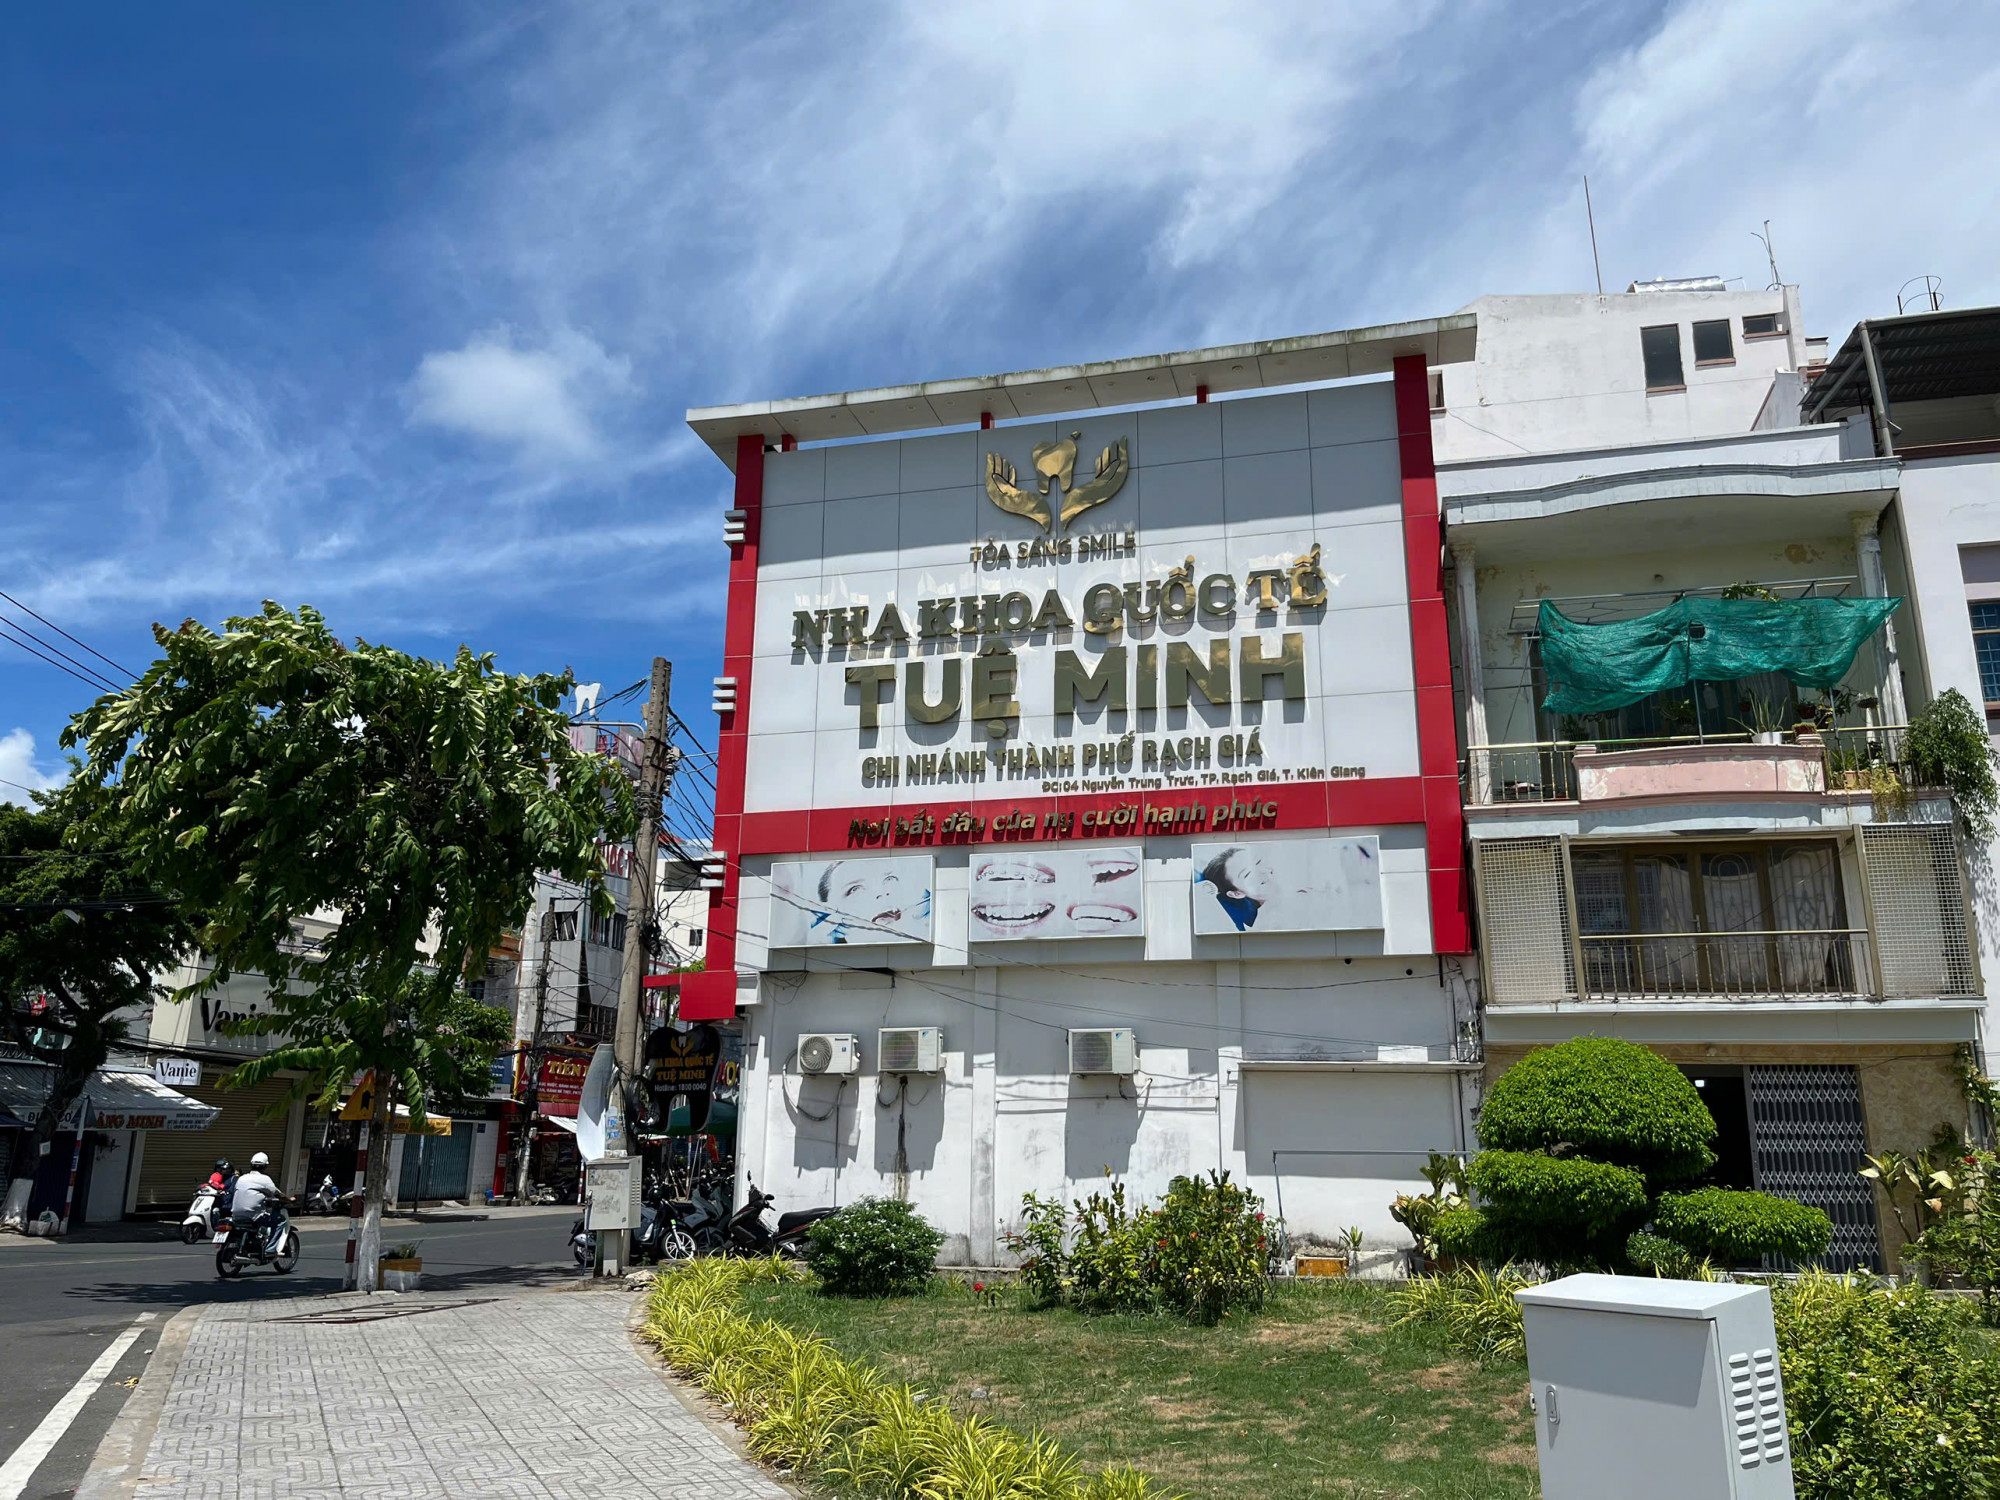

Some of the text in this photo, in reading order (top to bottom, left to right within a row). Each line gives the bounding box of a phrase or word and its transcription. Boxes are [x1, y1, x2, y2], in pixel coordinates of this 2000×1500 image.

[1017, 536, 1072, 559] SÁNG
[1078, 531, 1137, 553] SMILE
[792, 543, 1328, 648] NHA KHOA QUỐC TẾ
[845, 633, 1306, 738] TUỆ MINH
[862, 727, 1264, 779] CHI NHÁNH THÀNH PHỐ RẠCH GIÁ
[1082, 776, 1125, 793] Nguyễn
[1128, 777, 1162, 790] Trung
[1221, 771, 1253, 786] Rạch
[1297, 766, 1325, 780] Kiên
[1330, 765, 1366, 779] Giang
[894, 808, 936, 836] bắt
[940, 807, 986, 833] đầu
[992, 808, 1036, 831] của
[1081, 802, 1138, 826] cười
[1143, 801, 1207, 828] hạnh
[1211, 797, 1278, 827] phúc
[158, 1061, 197, 1078] Vanie
[656, 1068, 677, 1083] TUỆ
[679, 1069, 706, 1081] MINH
[127, 1115, 167, 1128] MINH
